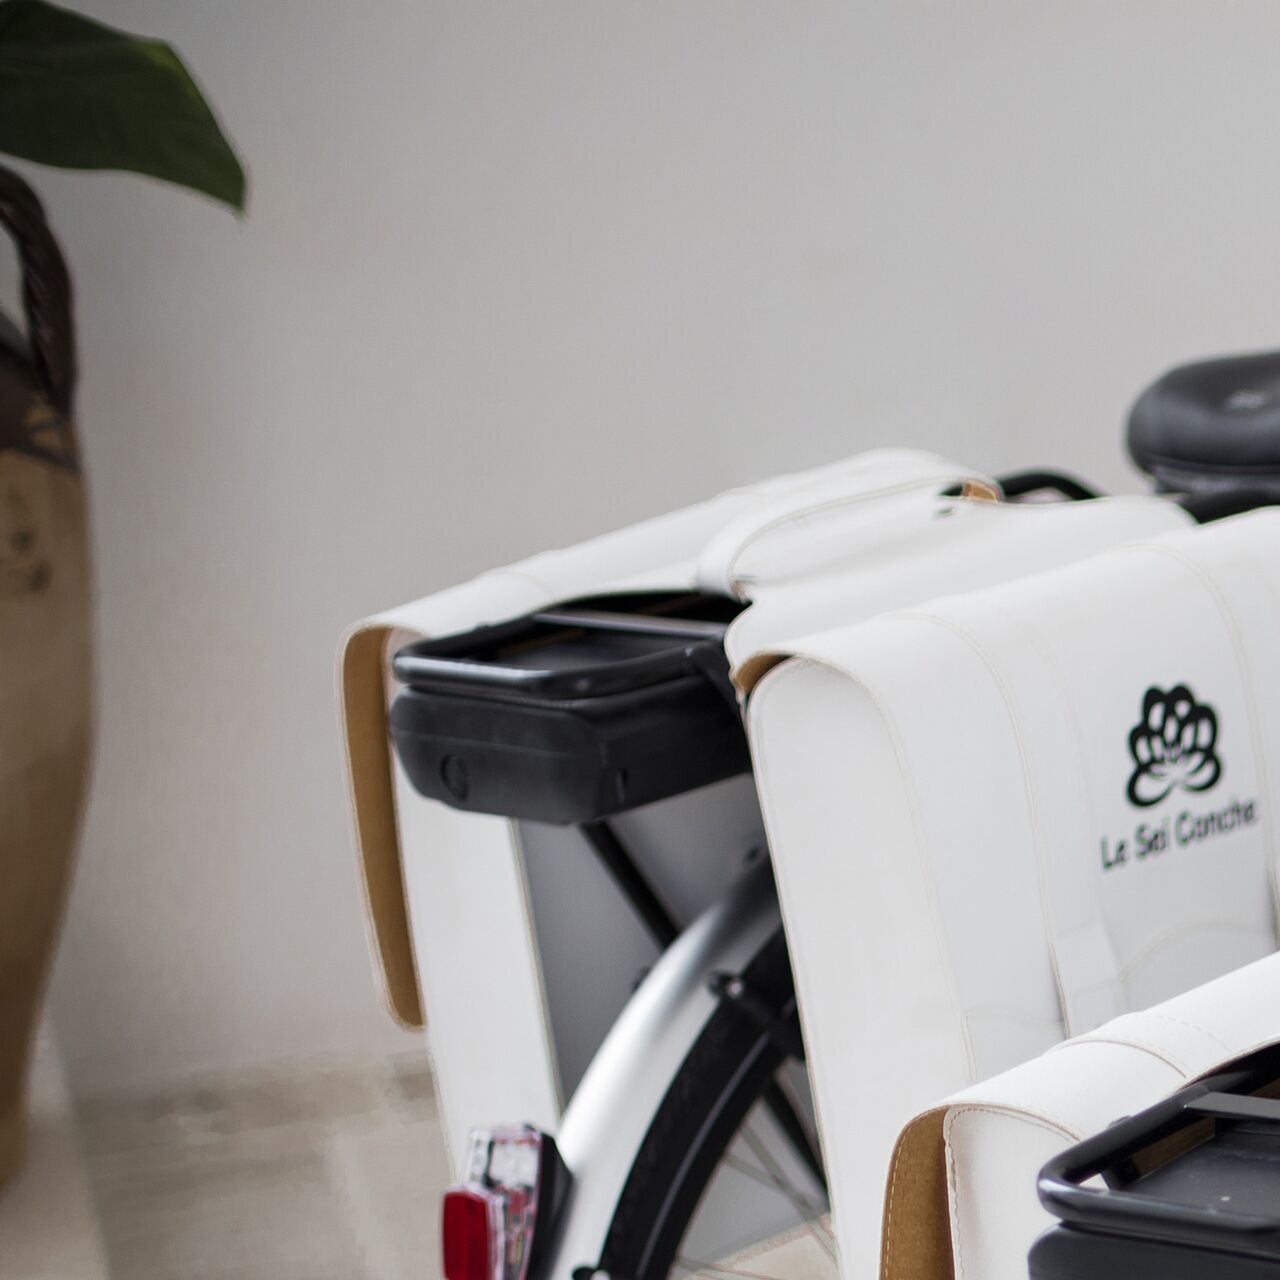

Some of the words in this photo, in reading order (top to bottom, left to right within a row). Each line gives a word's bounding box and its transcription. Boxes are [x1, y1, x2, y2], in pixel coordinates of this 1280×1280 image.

[1101, 835, 1128, 871] Le
[1134, 815, 1170, 860] Sei
[1175, 798, 1258, 847] Conche
